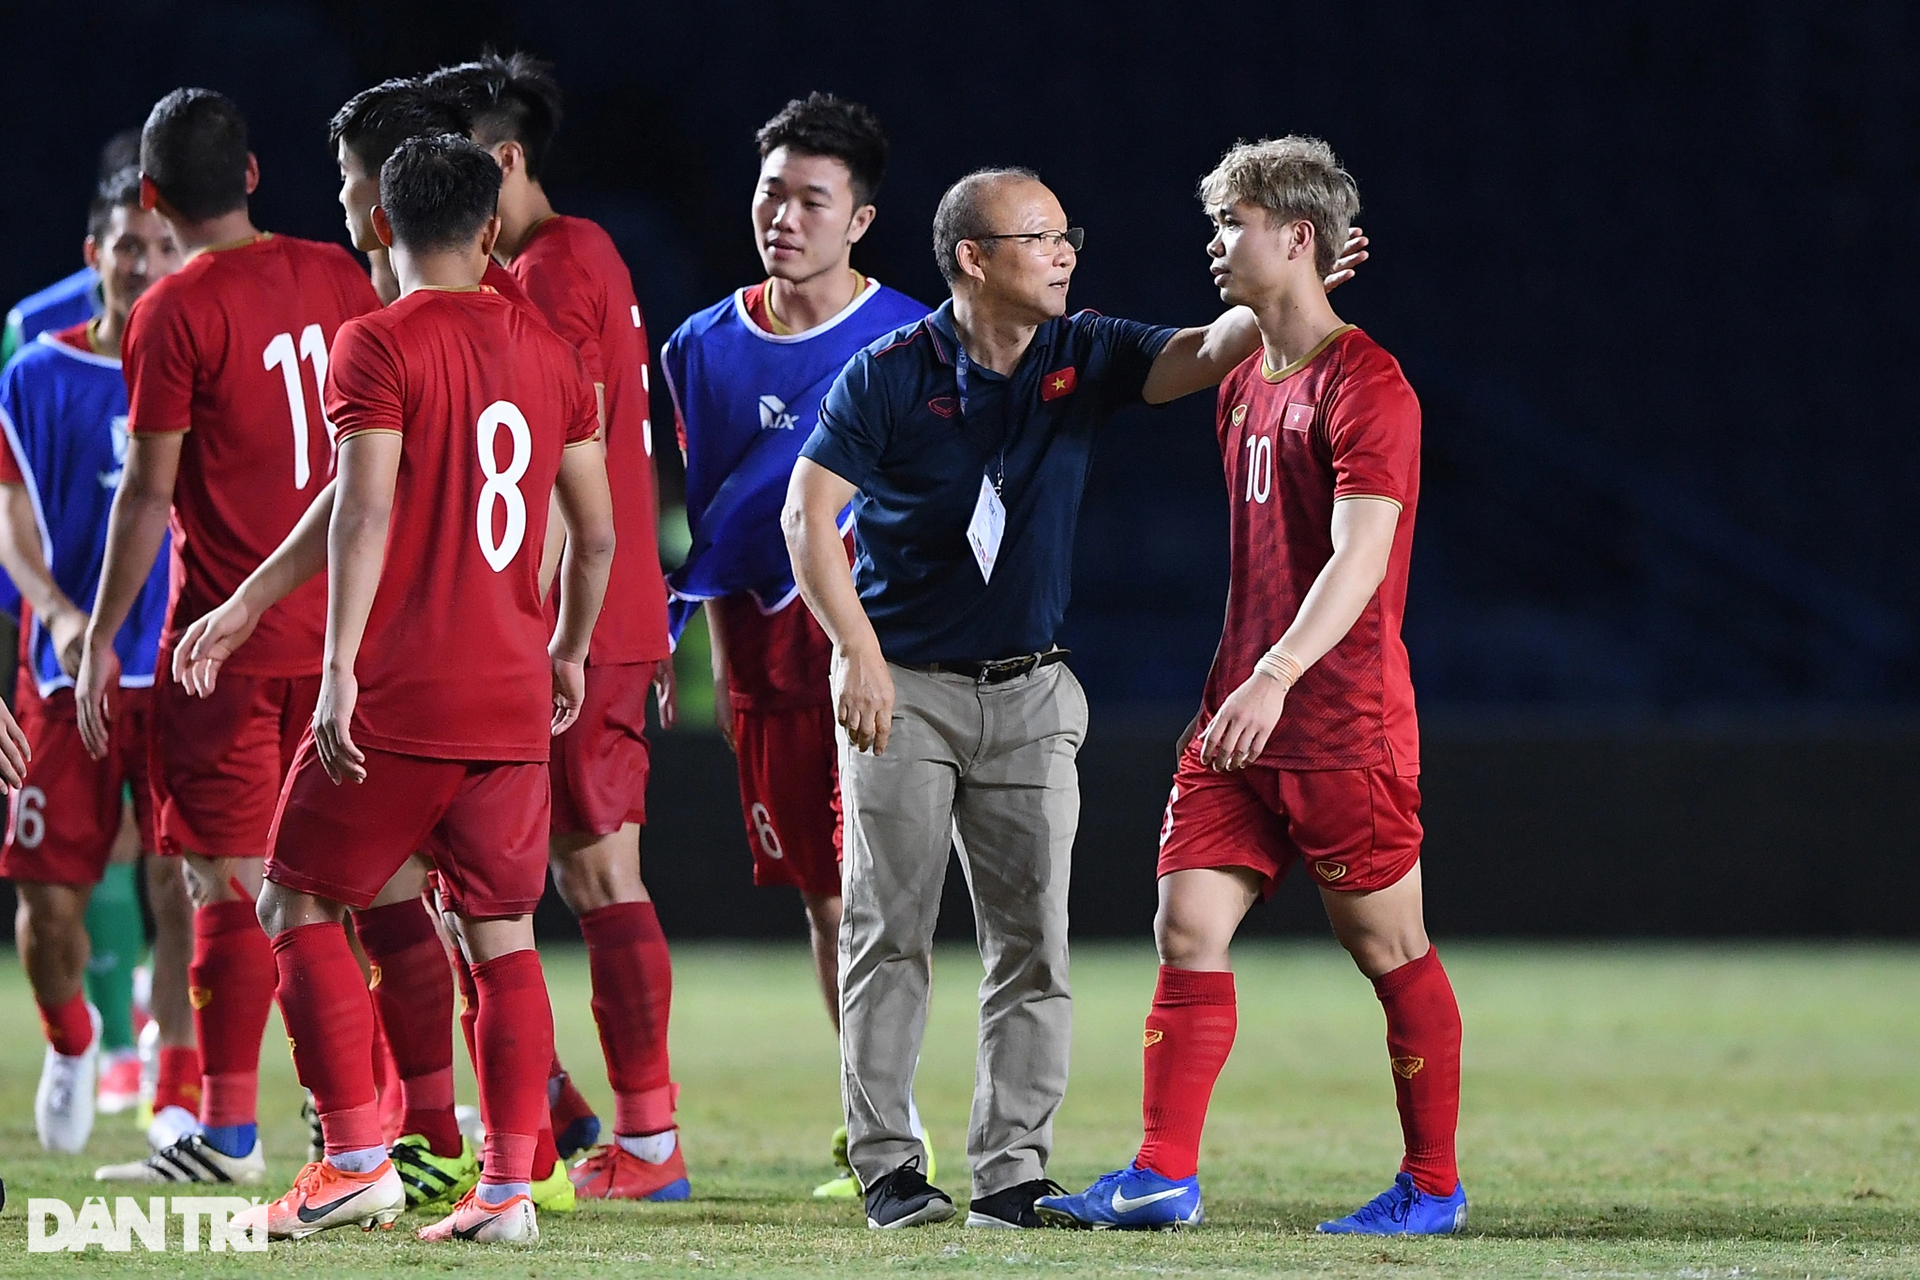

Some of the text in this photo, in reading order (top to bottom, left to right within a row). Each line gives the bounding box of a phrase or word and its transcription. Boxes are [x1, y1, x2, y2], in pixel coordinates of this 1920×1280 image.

[263, 323, 338, 490] 11
[476, 400, 532, 573] 8
[1245, 434, 1271, 504] 10
[751, 802, 783, 859] 6
